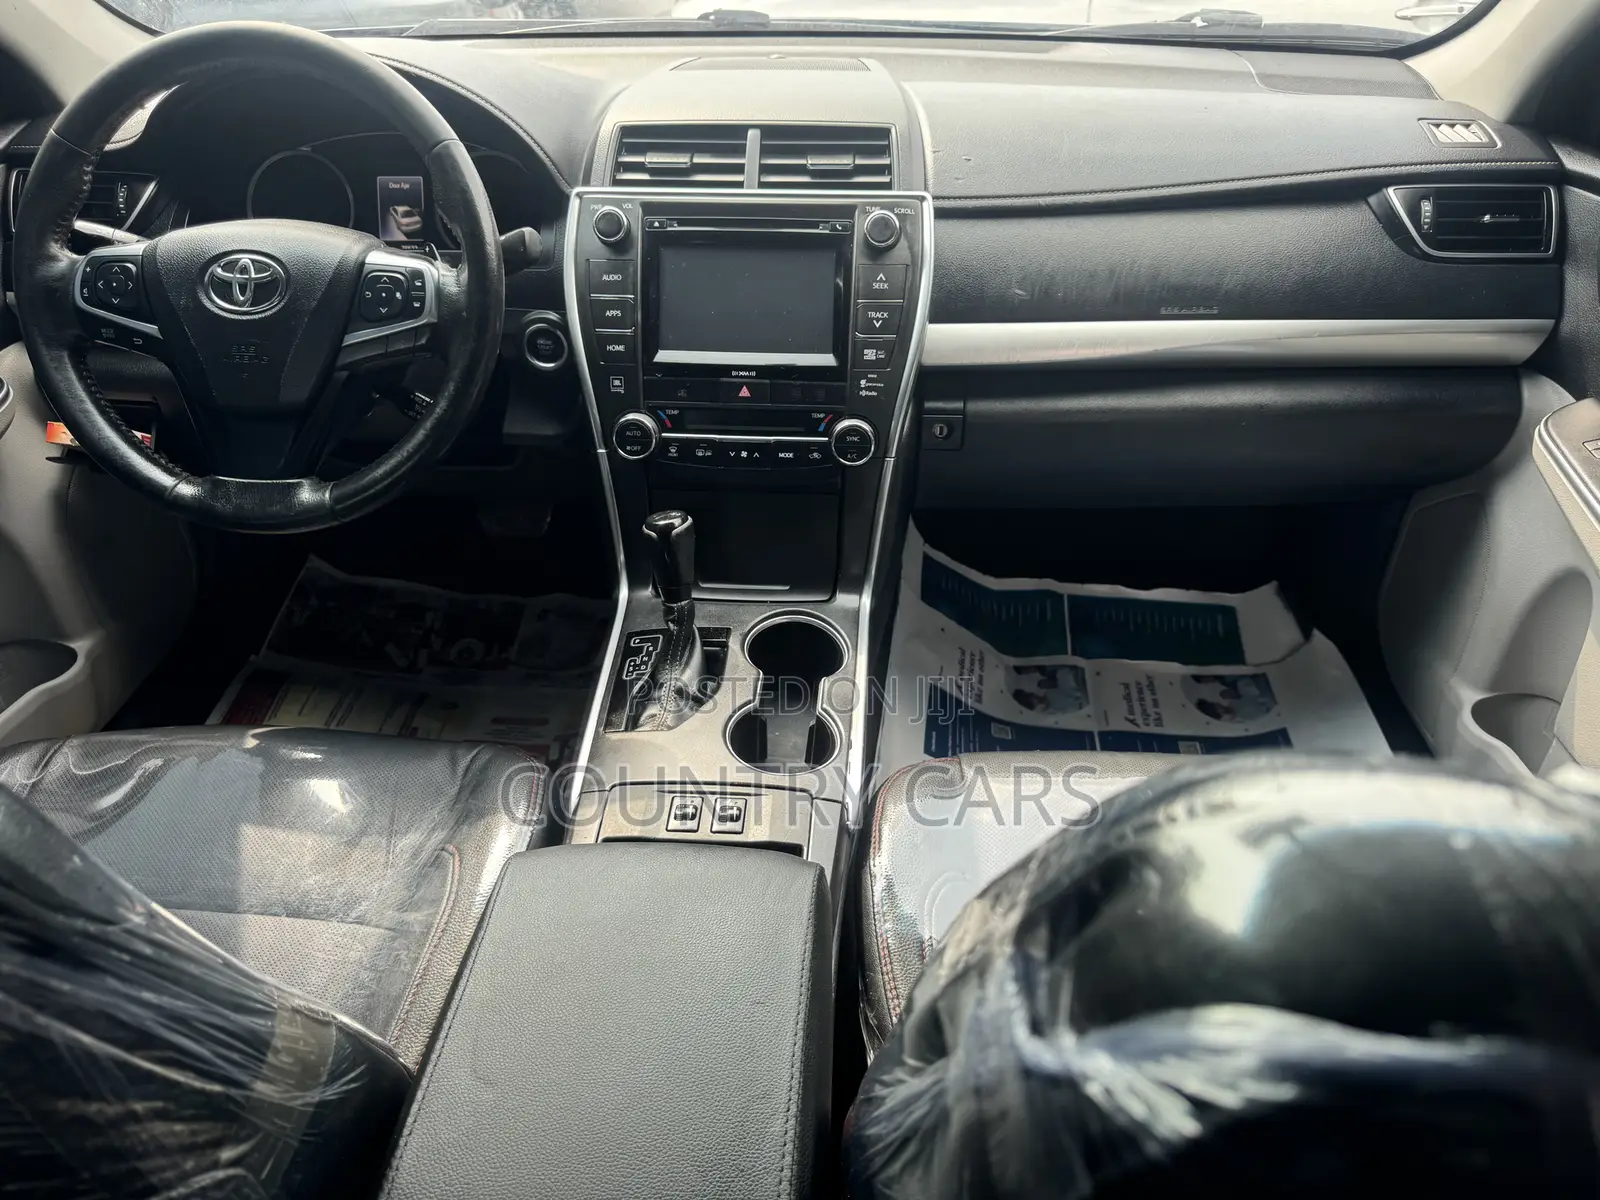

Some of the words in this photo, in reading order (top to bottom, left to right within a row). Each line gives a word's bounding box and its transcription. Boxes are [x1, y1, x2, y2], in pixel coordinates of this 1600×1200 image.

[622, 202, 634, 210] VOL
[893, 207, 916, 215] SCROLL
[601, 274, 622, 282] AUDIO
[872, 282, 889, 290] SEEK
[605, 309, 622, 317] APPS
[867, 311, 889, 319] TRACK
[606, 344, 626, 352] HOME
[665, 408, 680, 416] TEMP
[811, 412, 826, 420] TEMP
[625, 429, 642, 437] AUTO
[845, 435, 861, 443] SYNC
[778, 451, 794, 459] MODE
